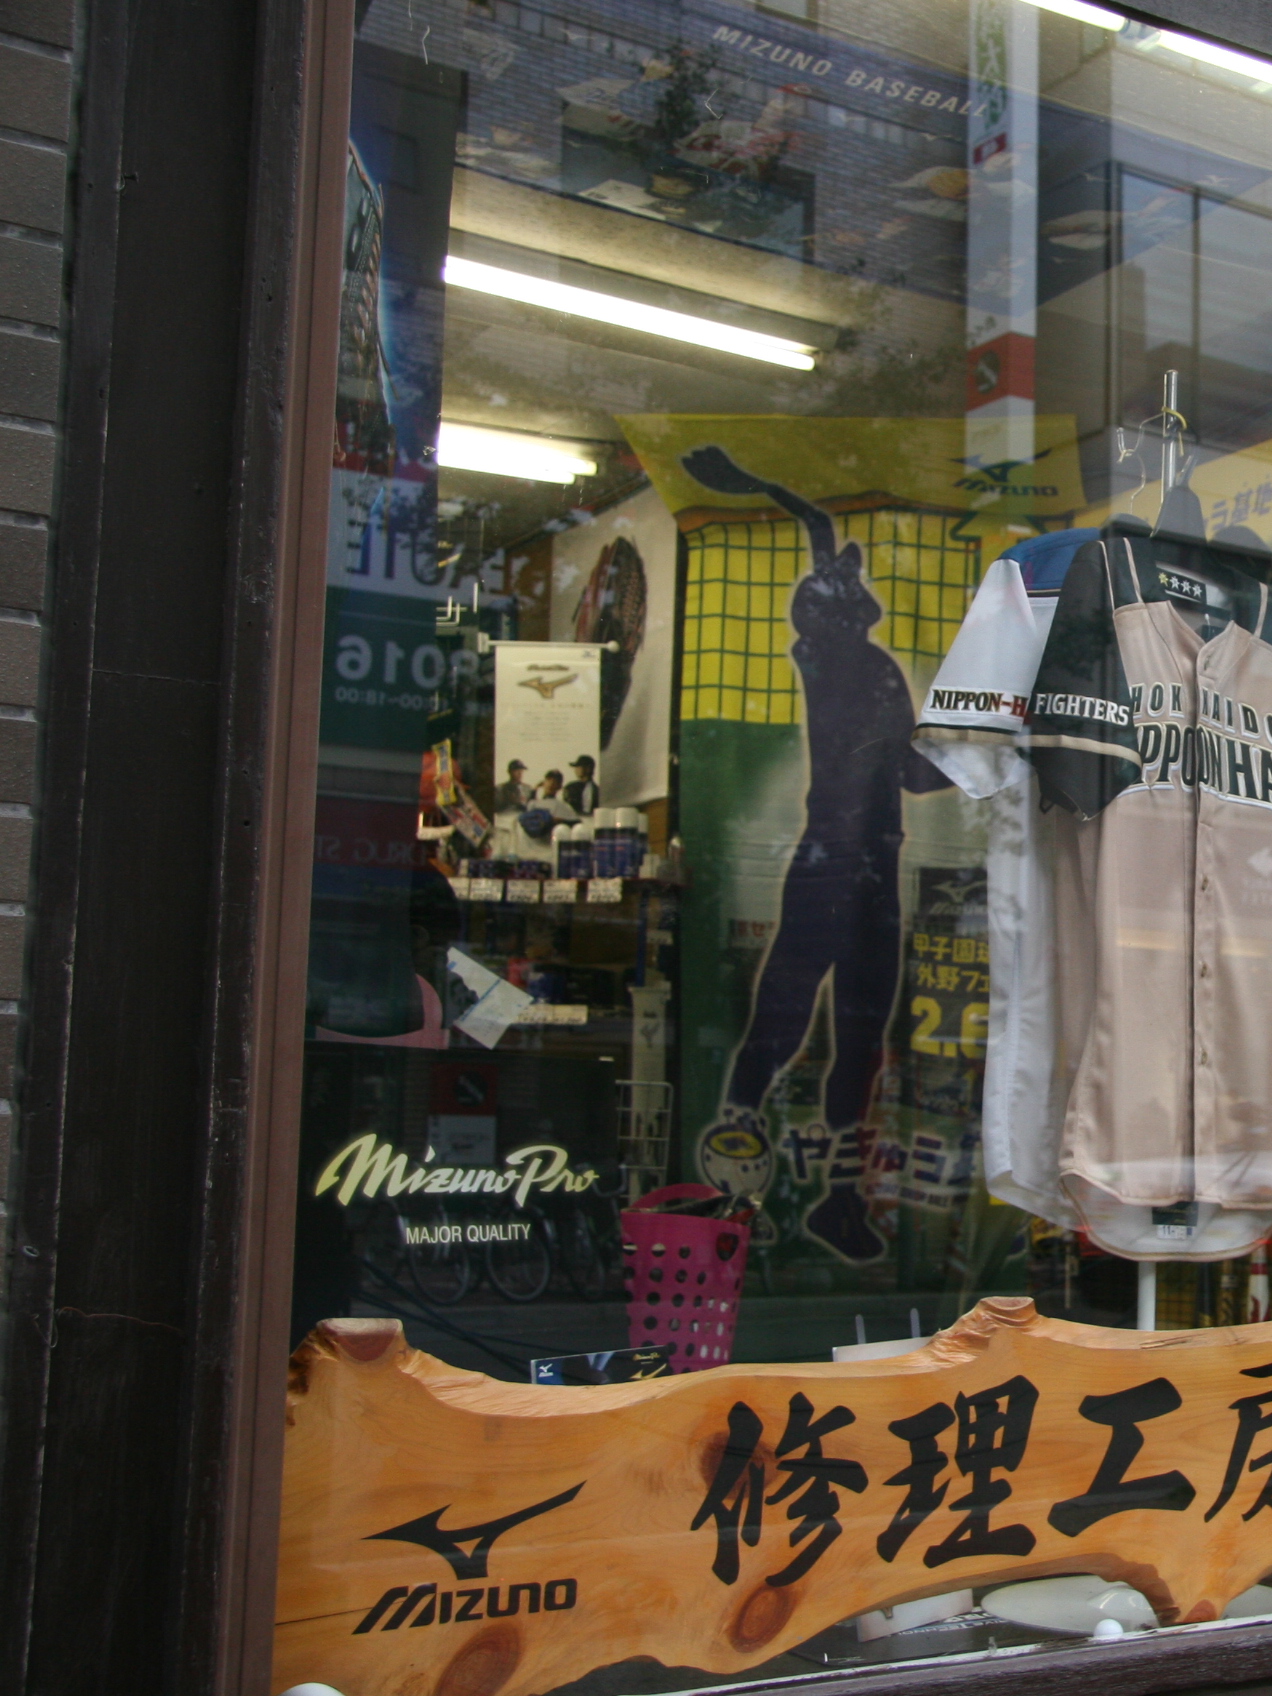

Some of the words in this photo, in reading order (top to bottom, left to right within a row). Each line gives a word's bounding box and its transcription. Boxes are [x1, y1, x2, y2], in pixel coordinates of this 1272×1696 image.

[712, 25, 833, 76] MIZUNO
[845, 69, 990, 118] BASEBALL
[1033, 692, 1130, 726] FIGHTERS
[315, 1133, 521, 1207] Mizuno
[505, 1144, 600, 1208] Pro
[405, 1226, 462, 1245] MAJOR
[467, 1223, 532, 1242] QUALITY
[352, 1577, 578, 1635] MIZUNO
